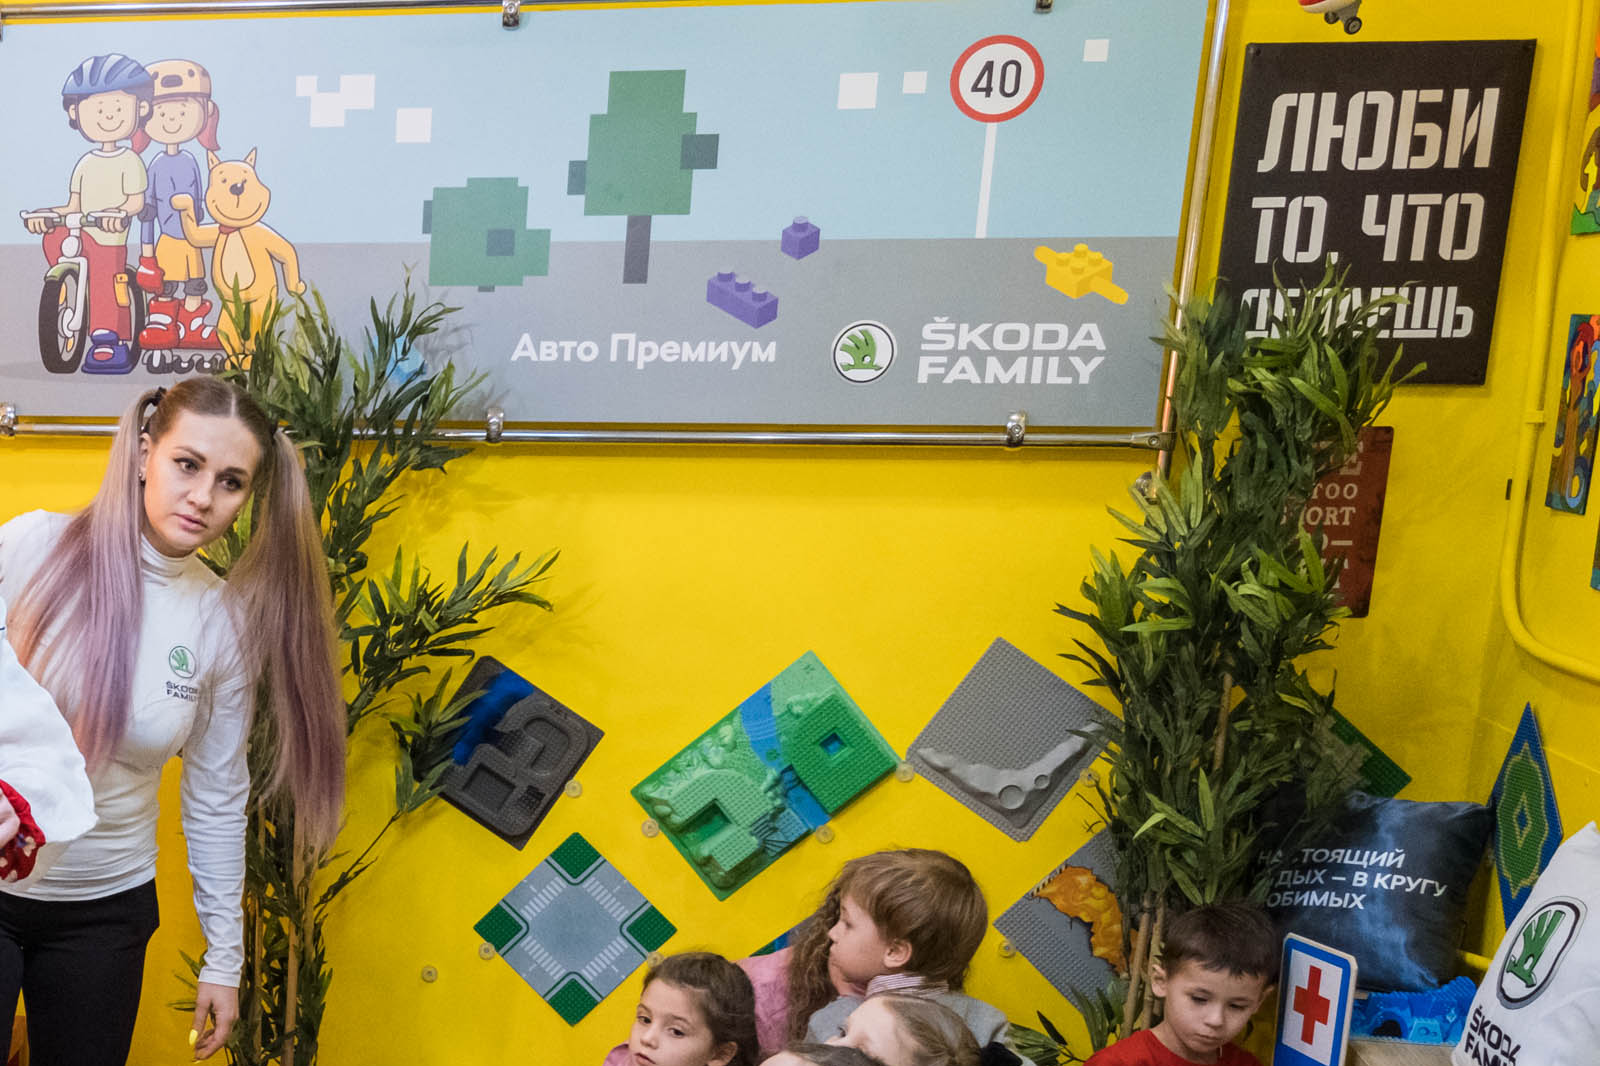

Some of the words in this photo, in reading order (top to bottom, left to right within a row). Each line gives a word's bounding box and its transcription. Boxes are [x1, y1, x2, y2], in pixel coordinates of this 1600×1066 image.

[970, 59, 1022, 98] 40
[1257, 87, 1500, 173] ЛЮБИ
[1251, 195, 1339, 265] ТО,
[1361, 192, 1485, 262] ЧТО
[510, 332, 600, 362] Авто
[609, 332, 777, 371] Премиум
[920, 316, 1107, 351] ŠKODA
[917, 356, 1106, 385] FAMILY
[1351, 870, 1368, 888] В
[1372, 872, 1449, 898] КРУГУ
